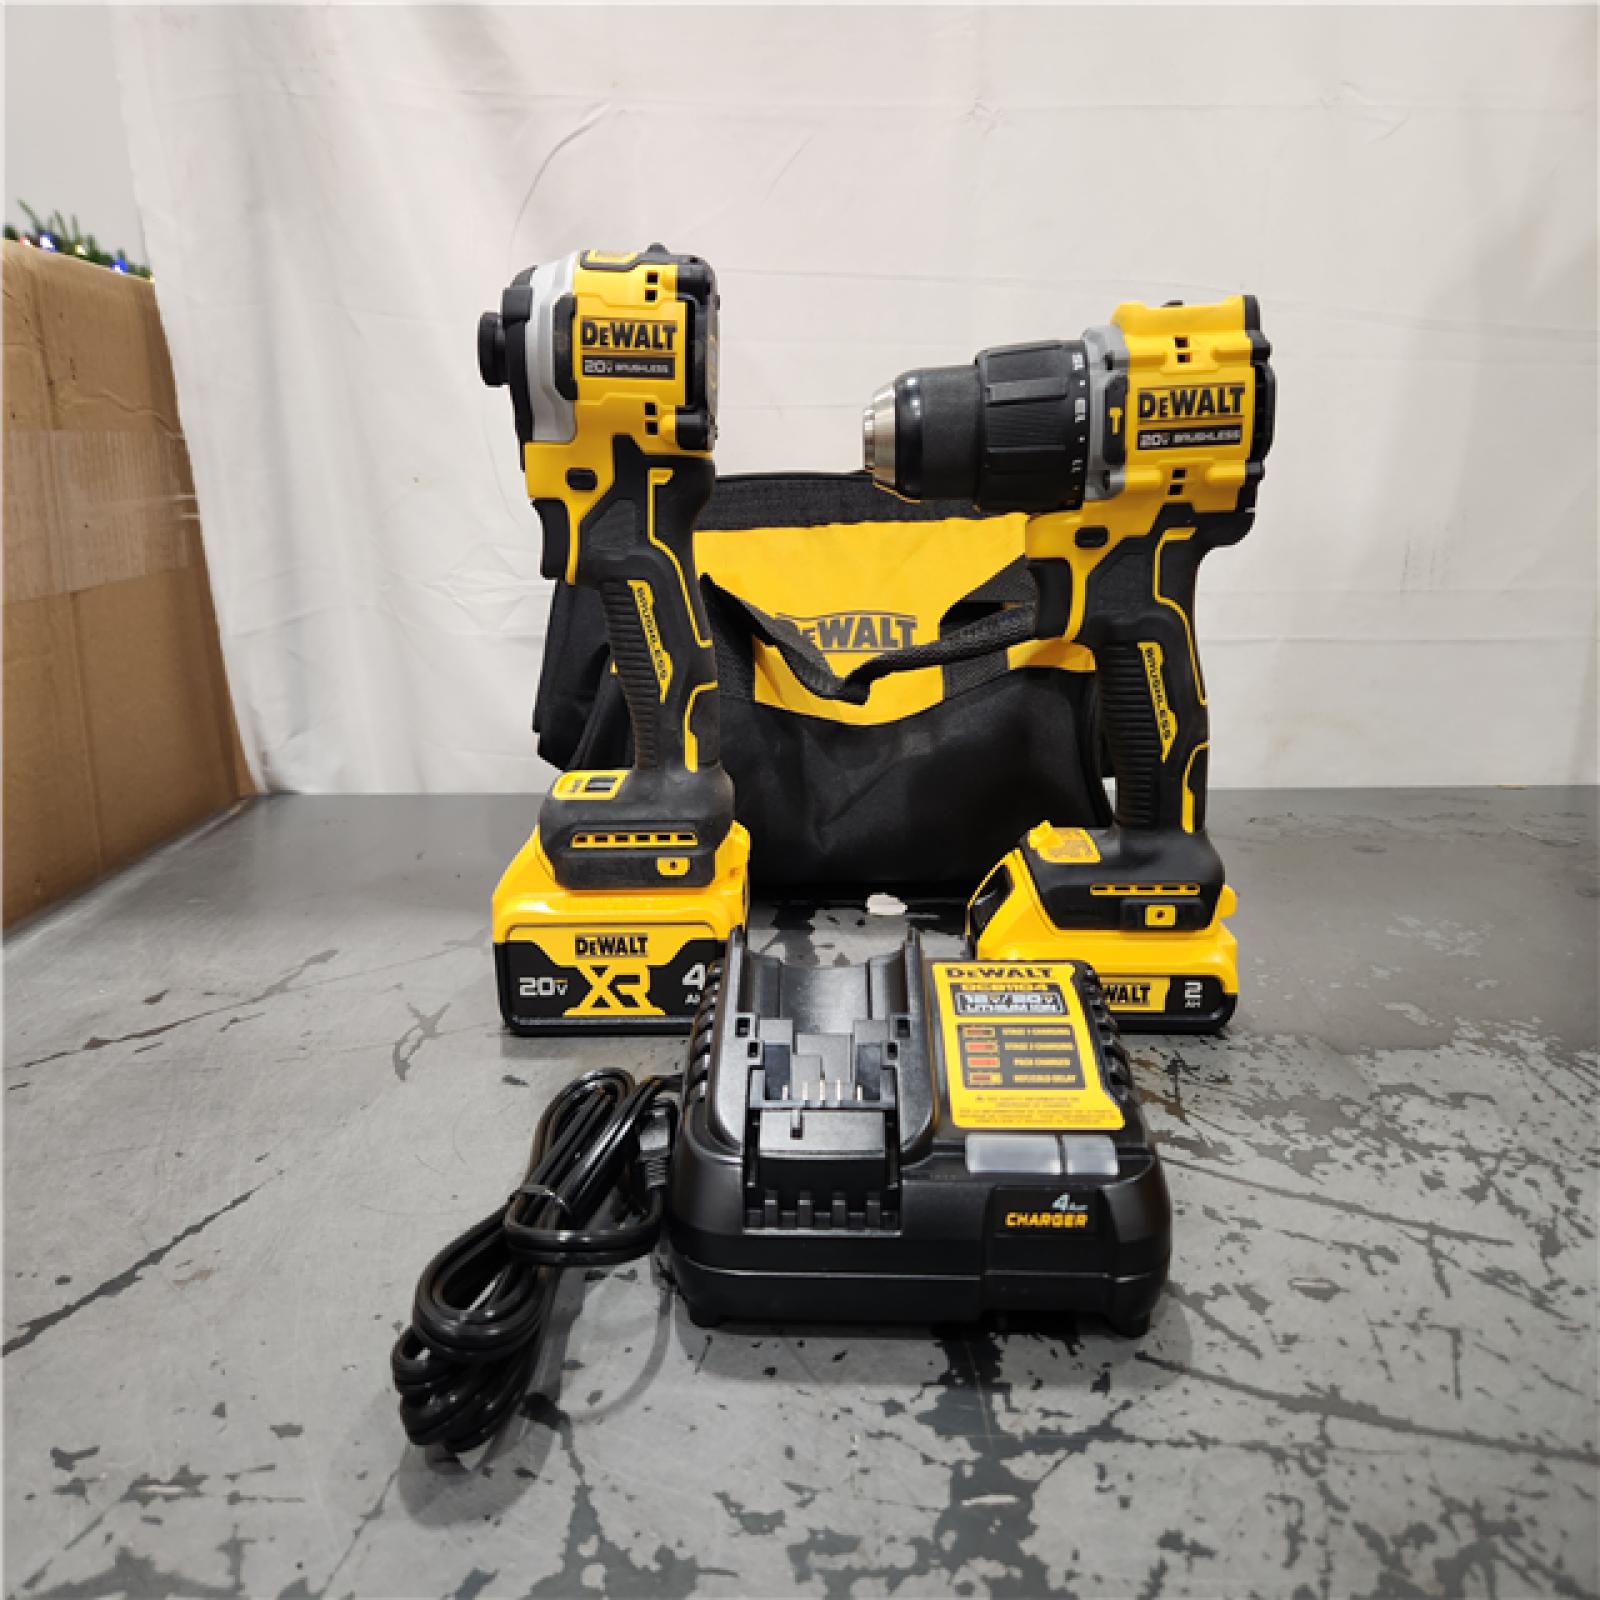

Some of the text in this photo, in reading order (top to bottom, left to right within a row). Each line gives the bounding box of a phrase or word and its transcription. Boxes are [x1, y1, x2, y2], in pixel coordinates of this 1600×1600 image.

[682, 962, 706, 990] 4
[1184, 980, 1203, 998] 2
[1005, 1211, 1089, 1228] CHARGER
